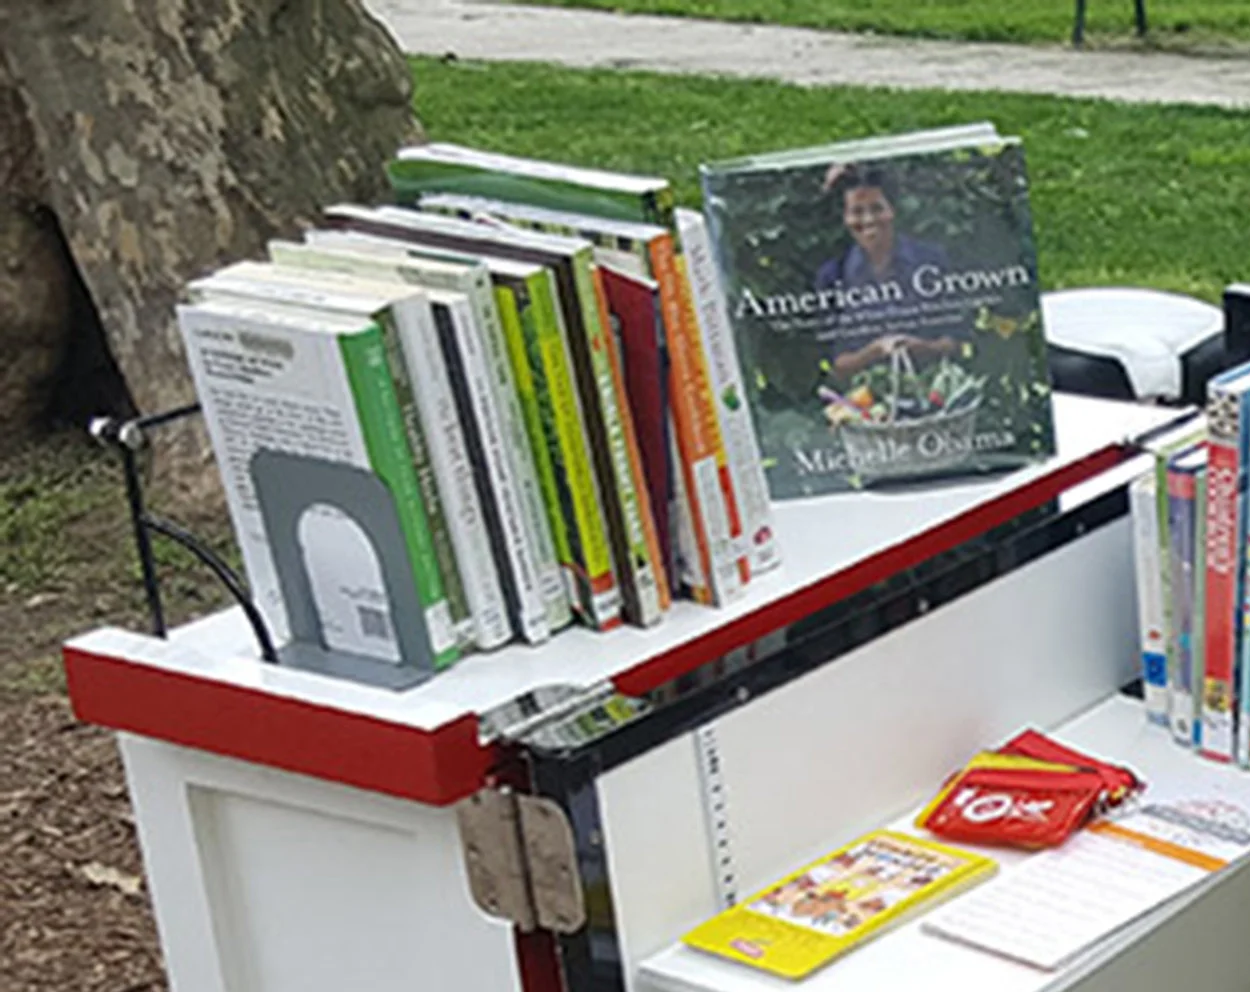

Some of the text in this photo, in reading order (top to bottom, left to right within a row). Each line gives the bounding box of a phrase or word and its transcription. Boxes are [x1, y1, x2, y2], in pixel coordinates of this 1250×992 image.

[735, 279, 903, 319] American
[911, 264, 1029, 298] Grown
[793, 431, 1016, 476] Michelle Obama
